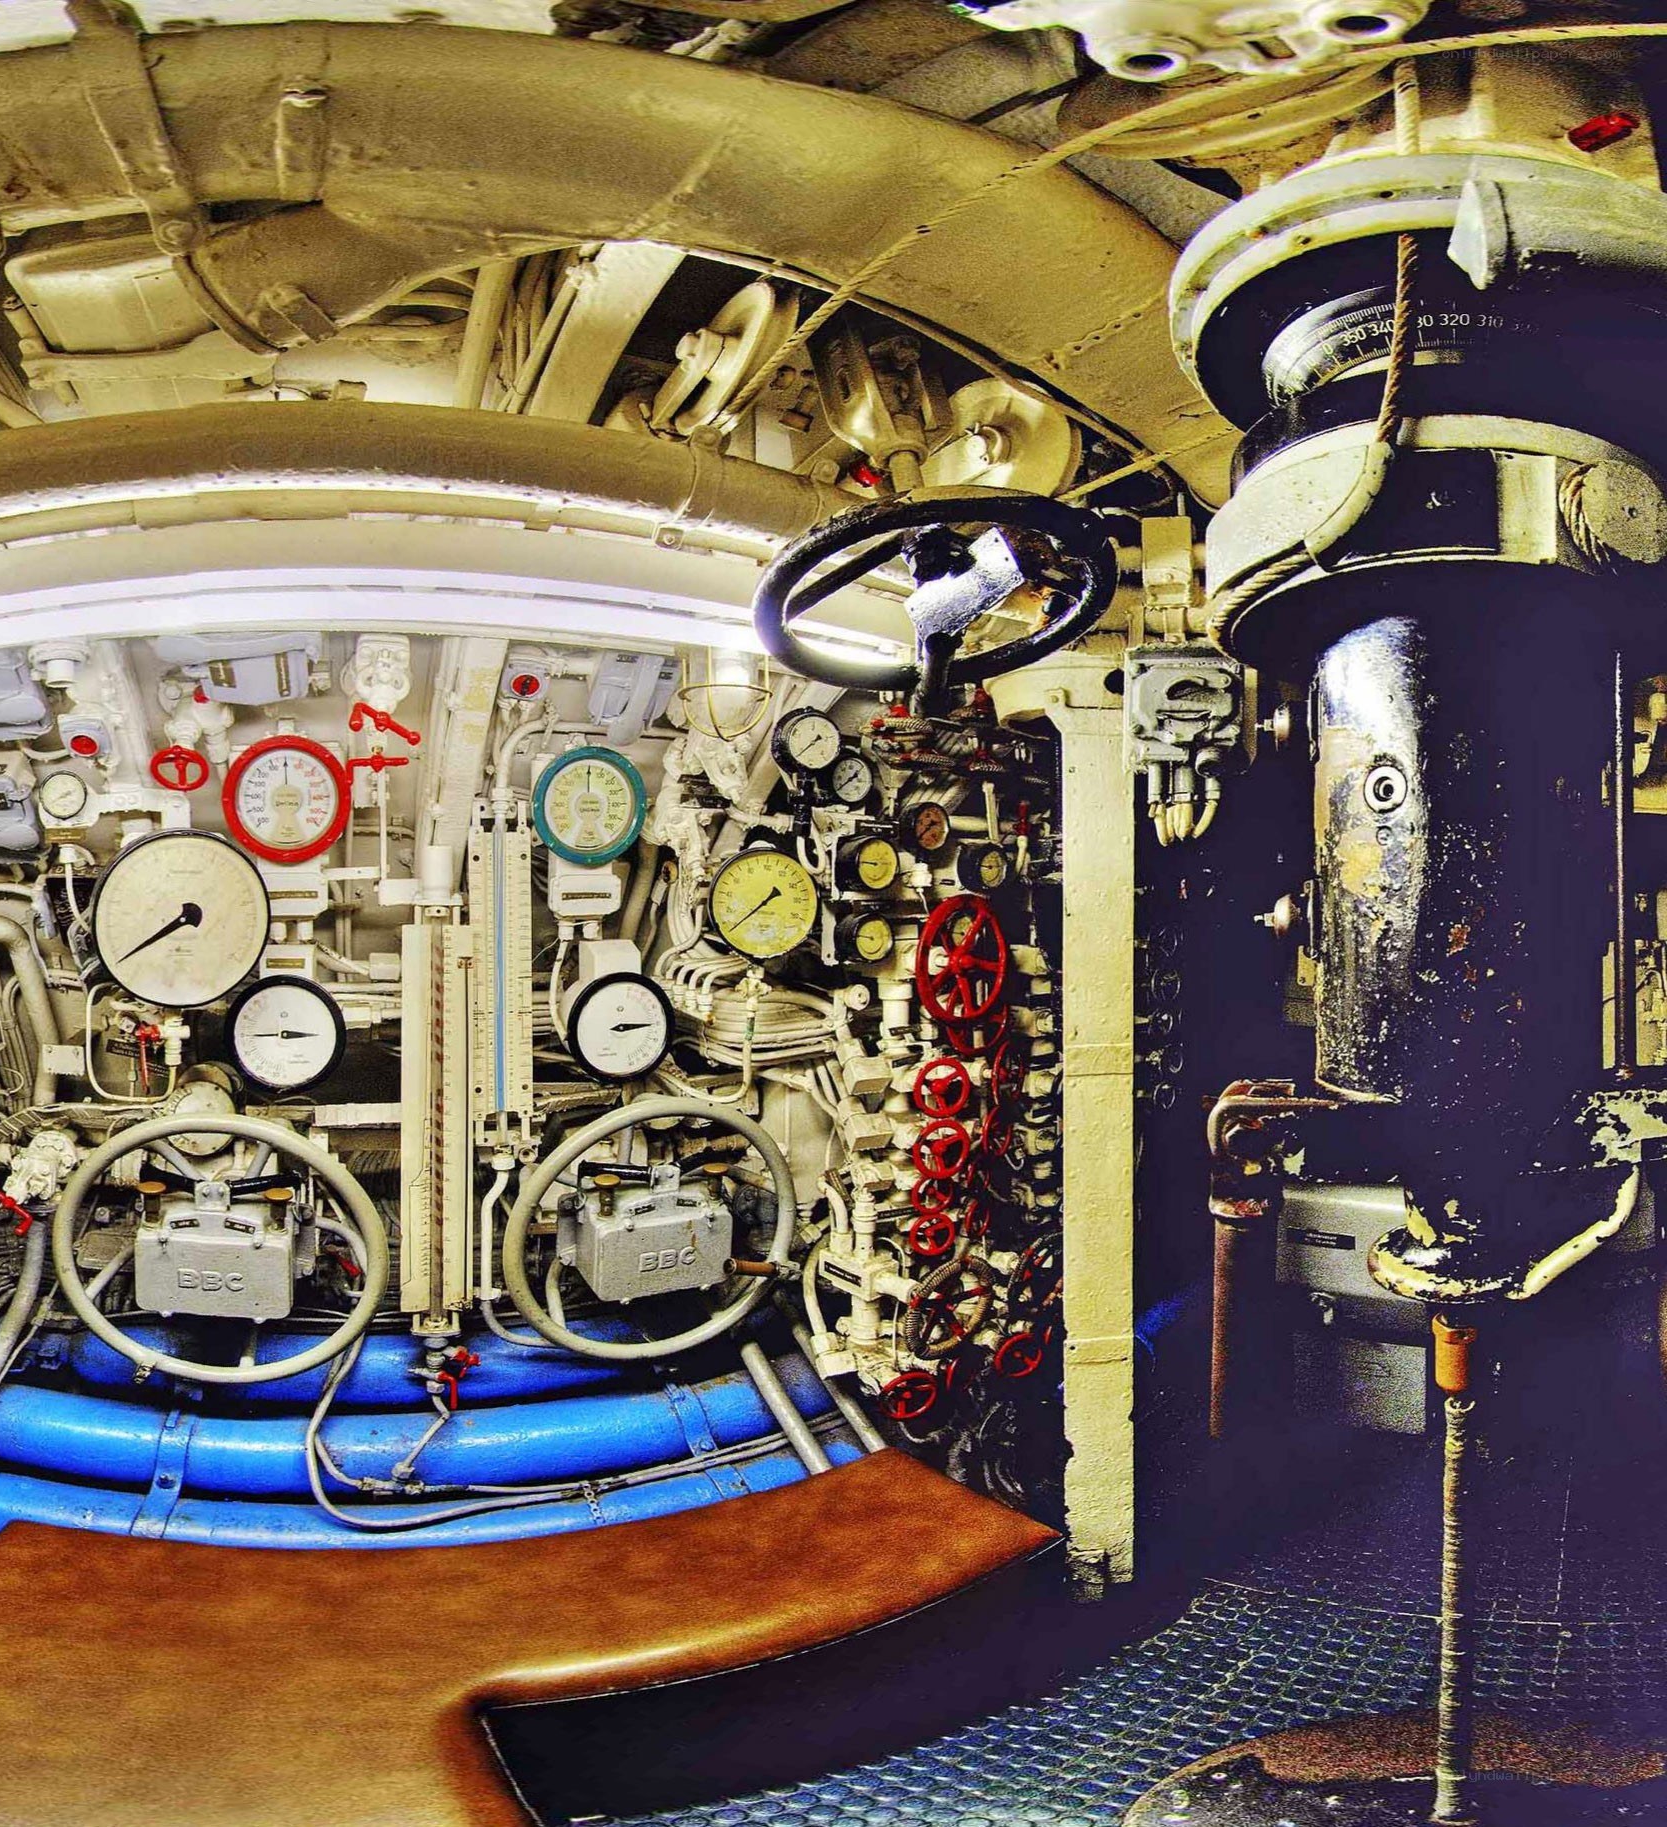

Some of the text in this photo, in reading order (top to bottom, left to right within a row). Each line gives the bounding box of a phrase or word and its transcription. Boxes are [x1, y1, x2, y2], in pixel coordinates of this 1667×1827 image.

[1342, 328, 1368, 347] 350
[1439, 312, 1470, 327] 320
[639, 1246, 696, 1273] BBC
[177, 1267, 245, 1292] BBC
